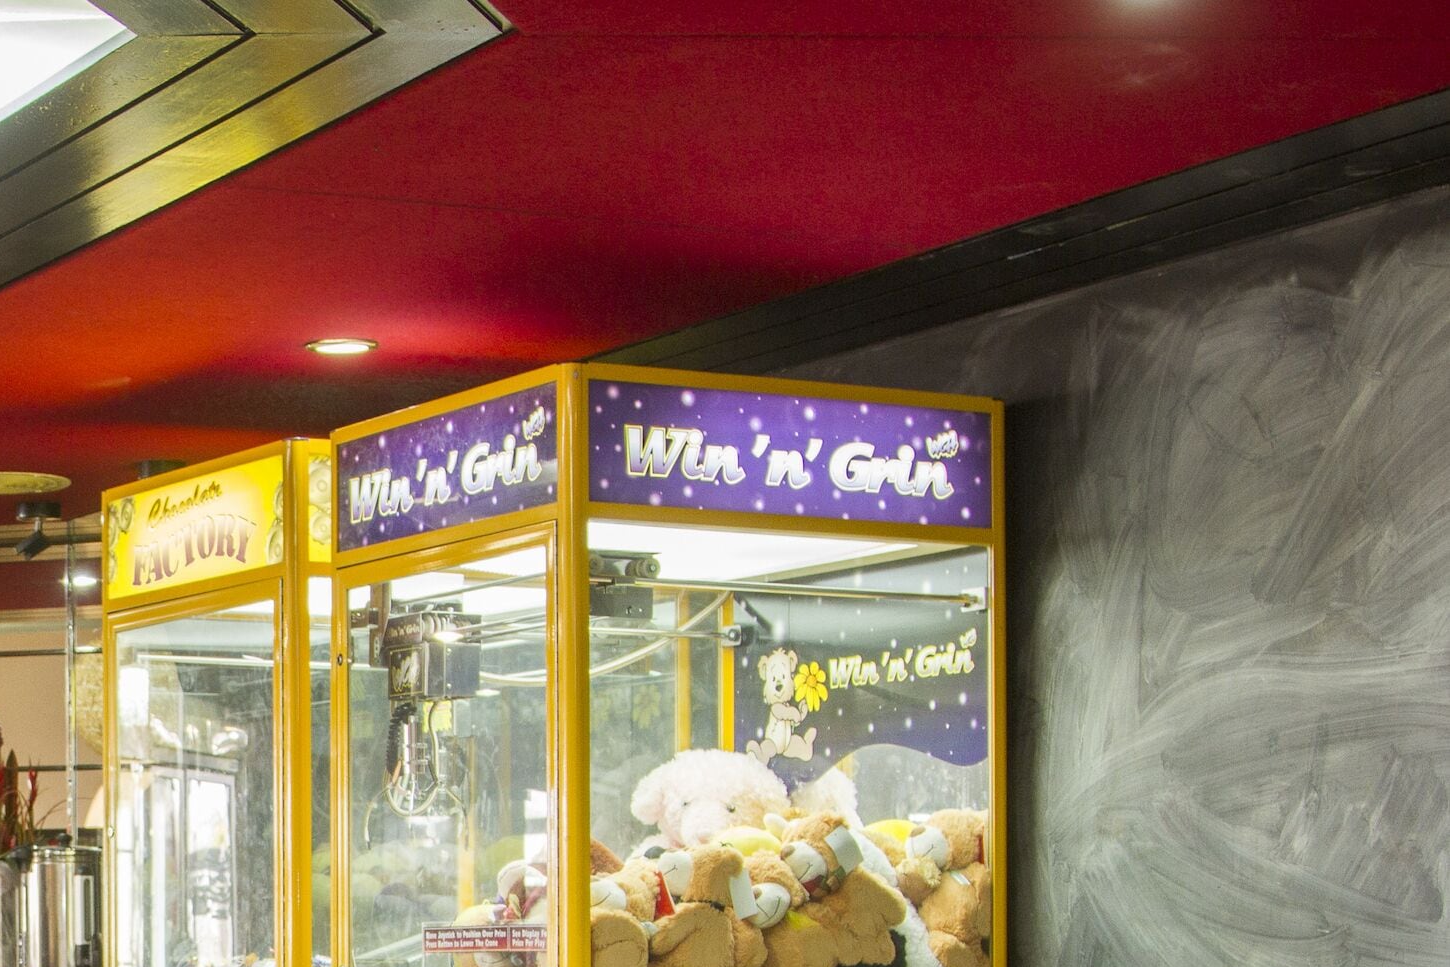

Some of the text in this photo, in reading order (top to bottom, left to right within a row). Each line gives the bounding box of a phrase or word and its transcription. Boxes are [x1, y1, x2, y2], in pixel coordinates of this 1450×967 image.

[349, 434, 543, 524] Win 'n' Grin
[624, 423, 954, 500] Win 'n' Grin
[148, 480, 223, 528] Chocolate
[133, 513, 257, 586] FACTORY
[828, 654, 880, 689] Win
[915, 642, 975, 678] Grin
[438, 931, 456, 940] Joystick
[463, 930, 481, 938] Position
[482, 930, 494, 938] Over
[512, 930, 520, 938] See
